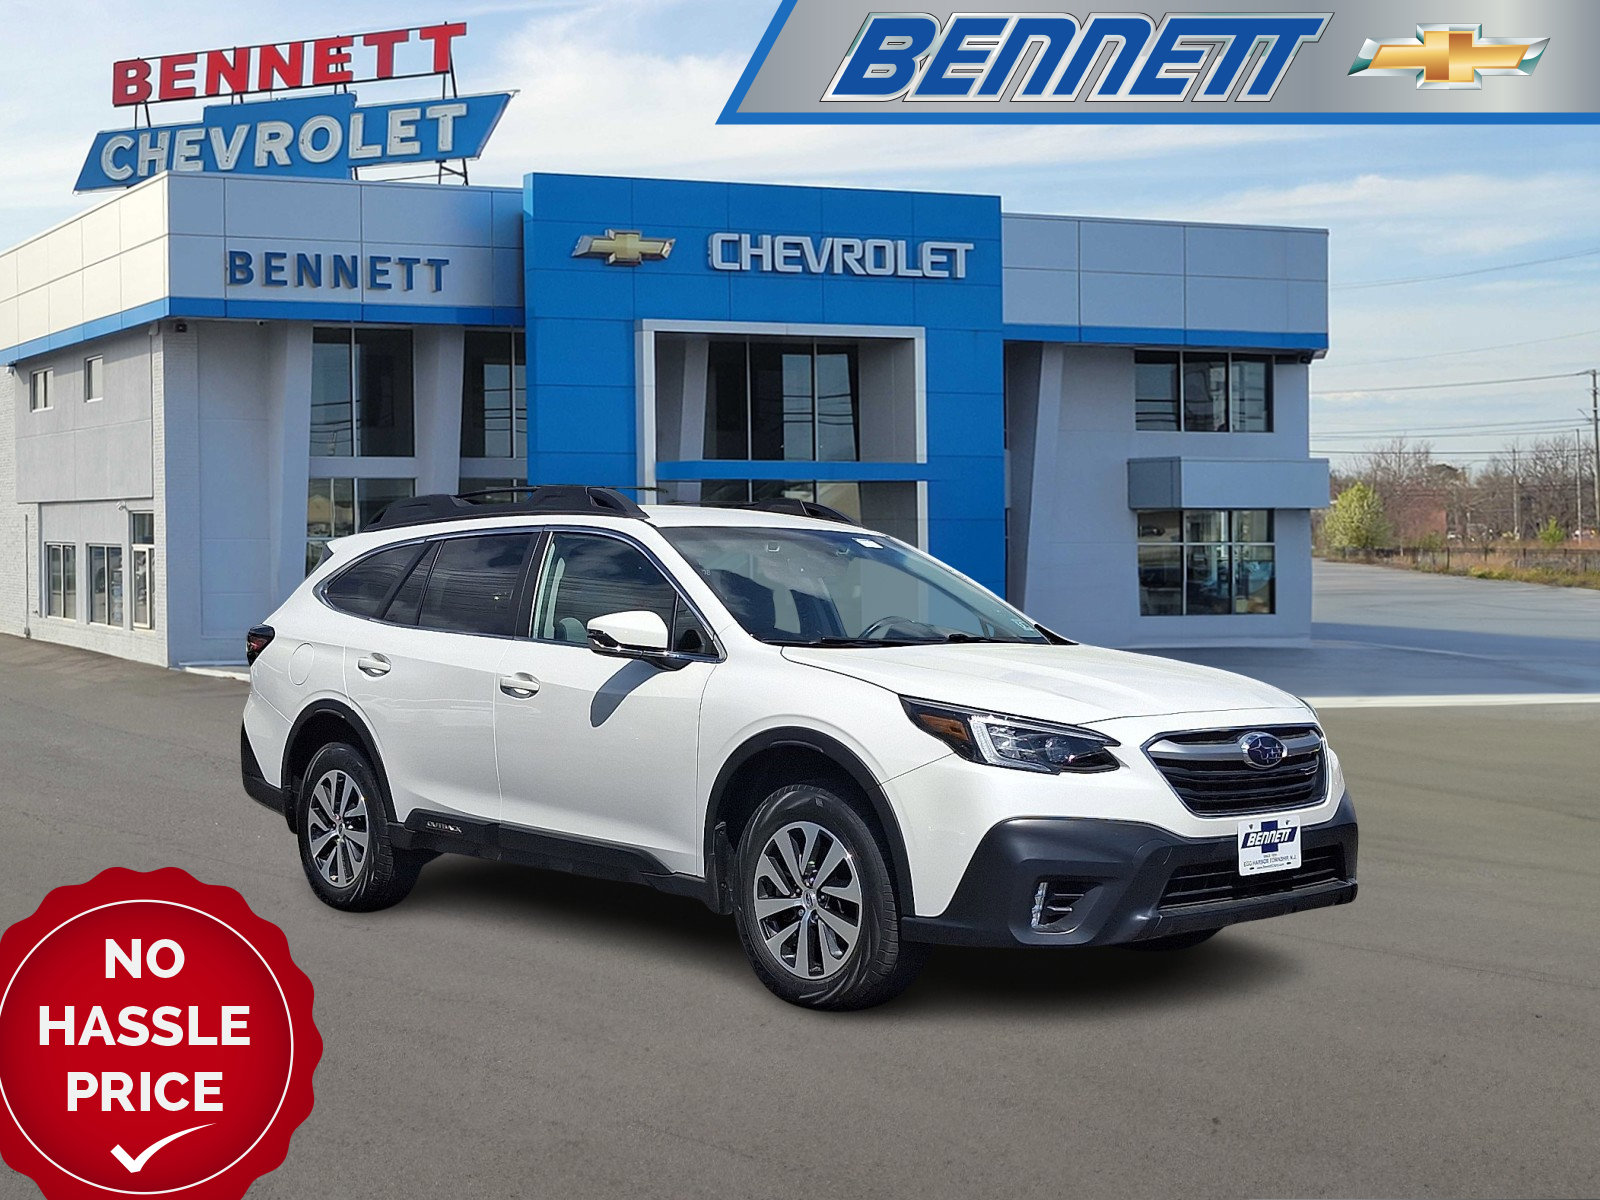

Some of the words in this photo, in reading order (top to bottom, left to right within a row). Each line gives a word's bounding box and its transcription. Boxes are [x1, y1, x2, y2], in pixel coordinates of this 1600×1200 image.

[113, 22, 467, 106] BENNETT
[99, 103, 468, 181] CHEVROLET
[226, 250, 449, 293] BENNETT
[708, 232, 974, 280] CHEVROLET
[1247, 828, 1292, 847] BENNETT
